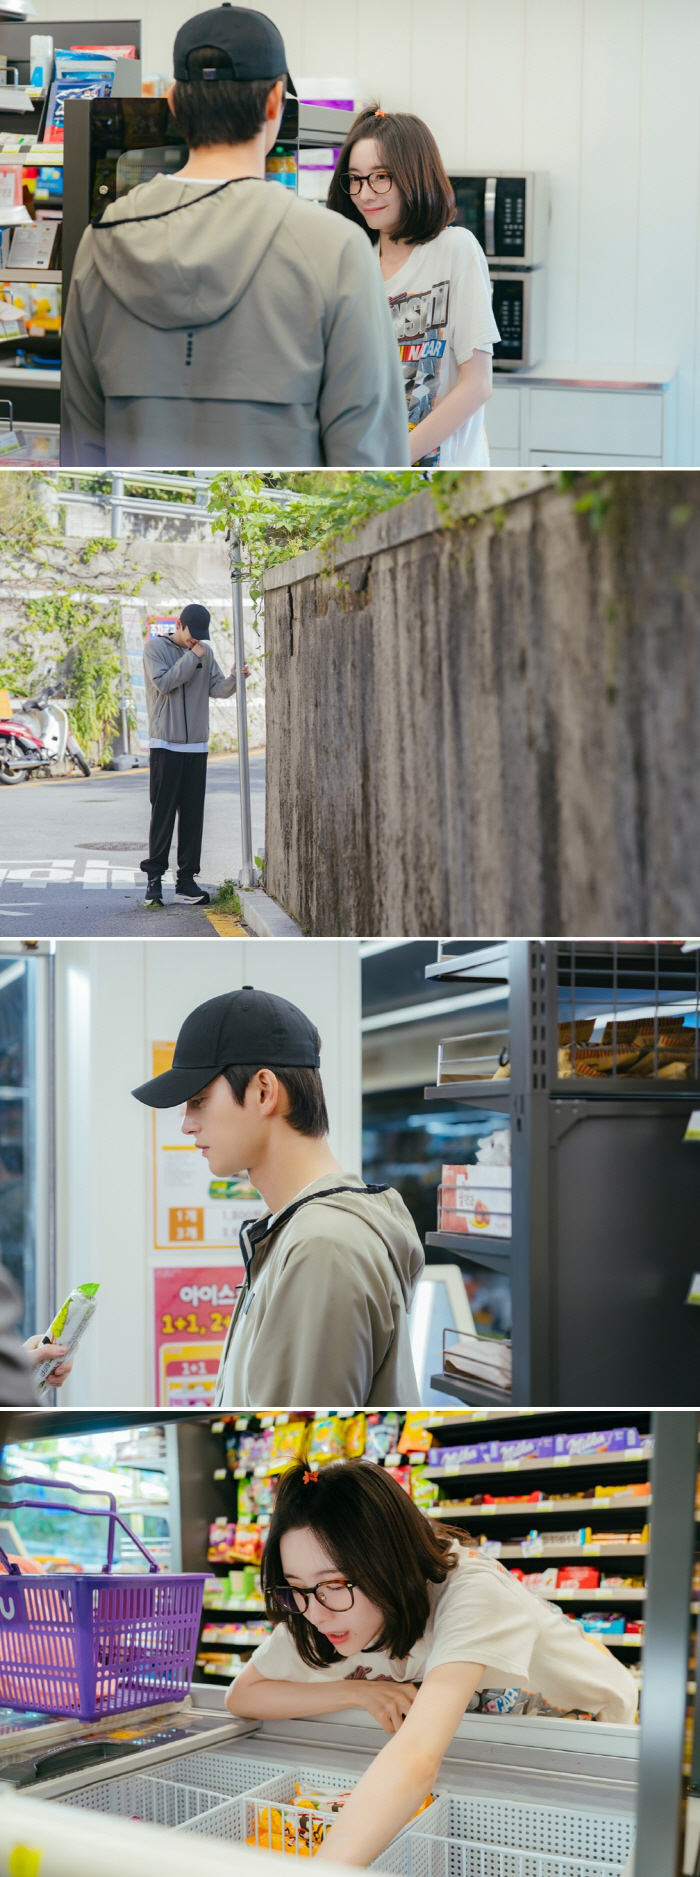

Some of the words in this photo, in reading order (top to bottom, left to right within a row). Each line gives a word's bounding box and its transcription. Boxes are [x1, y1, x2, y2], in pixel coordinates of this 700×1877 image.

[179, 1284, 240, 1307] 아이스
[161, 1312, 207, 1335] 1+1,
[181, 1361, 207, 1375] 1+1
[499, 1440, 535, 1460] Milka
[566, 1431, 606, 1456] Milka
[440, 1447, 477, 1465] Milka
